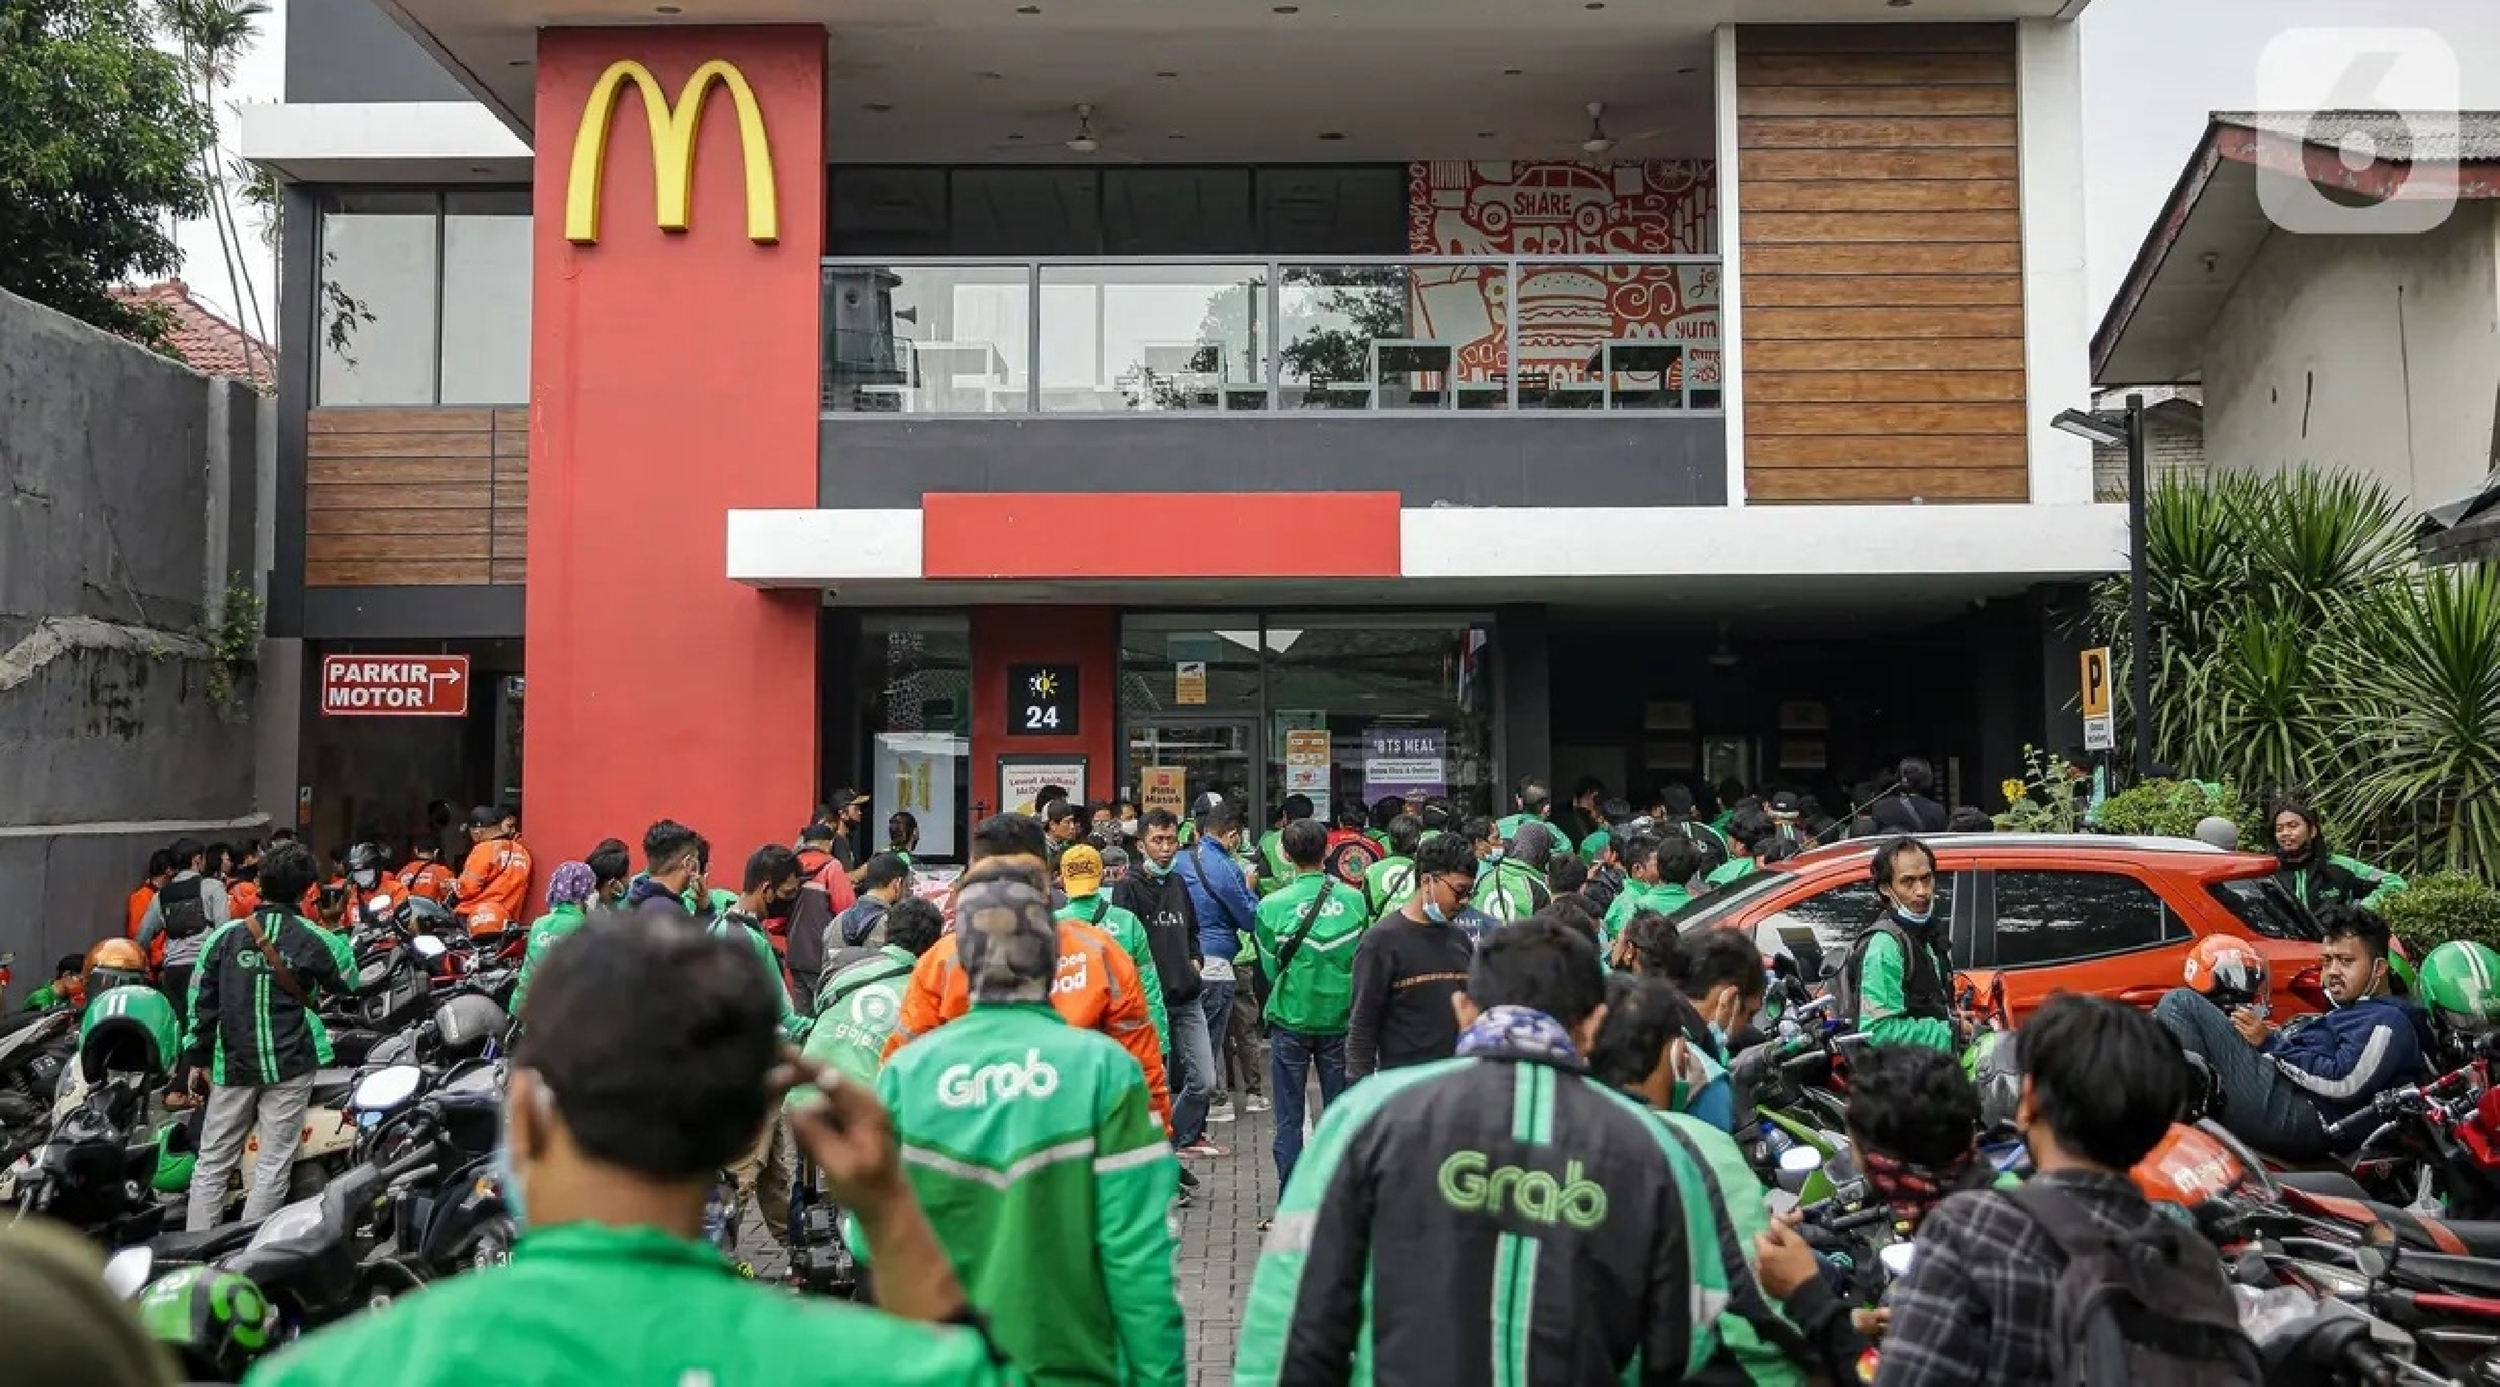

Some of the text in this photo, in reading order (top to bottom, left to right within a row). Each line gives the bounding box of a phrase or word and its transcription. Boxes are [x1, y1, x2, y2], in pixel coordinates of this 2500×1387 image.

[1513, 191, 1573, 216] SHARE
[330, 663, 428, 683] PARKIR
[2089, 654, 2102, 705] P
[328, 687, 425, 707] MOTOR
[1026, 705, 1061, 728] 24
[1405, 739, 1435, 753] MEAL
[1297, 897, 1345, 918] Gab
[1057, 951, 1087, 971] pee
[938, 1047, 1058, 1107] Grab
[1438, 1150, 1608, 1230] Grab
